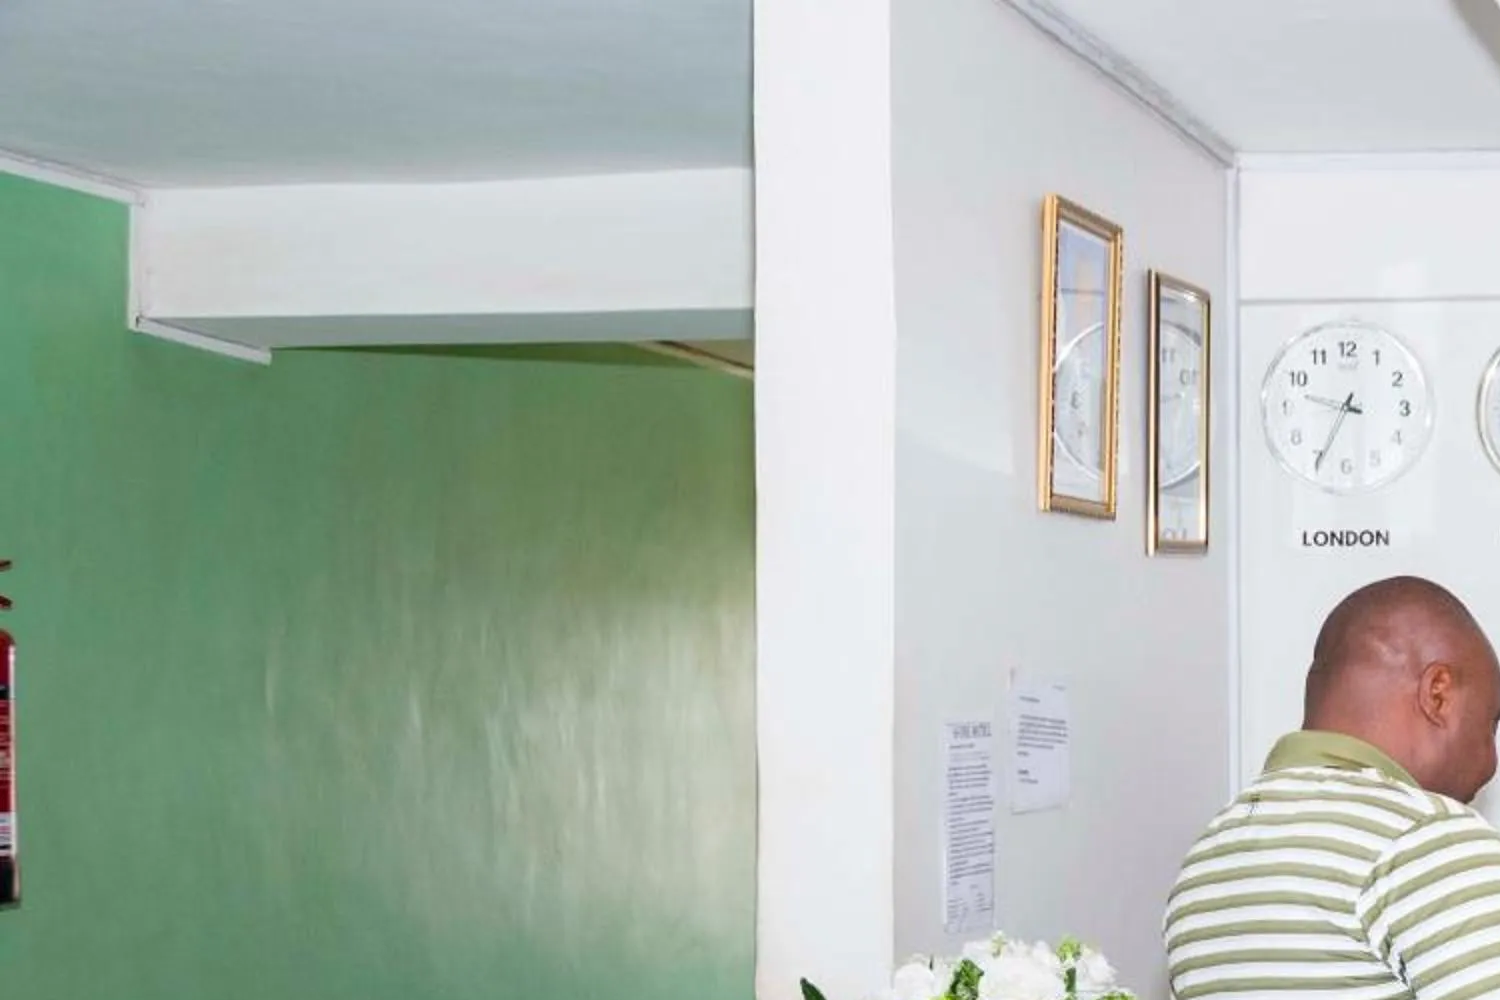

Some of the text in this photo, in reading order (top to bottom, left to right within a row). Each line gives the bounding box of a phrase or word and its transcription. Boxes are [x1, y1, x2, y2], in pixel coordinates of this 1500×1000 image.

[1311, 348, 1328, 366] 11
[1337, 340, 1359, 358] 12
[1372, 348, 1381, 367] 1
[1290, 369, 1309, 388] 10
[1391, 369, 1404, 388] 2
[1399, 399, 1411, 417] 3
[1340, 458, 1353, 475] 6
[1302, 530, 1390, 547] LONDON
